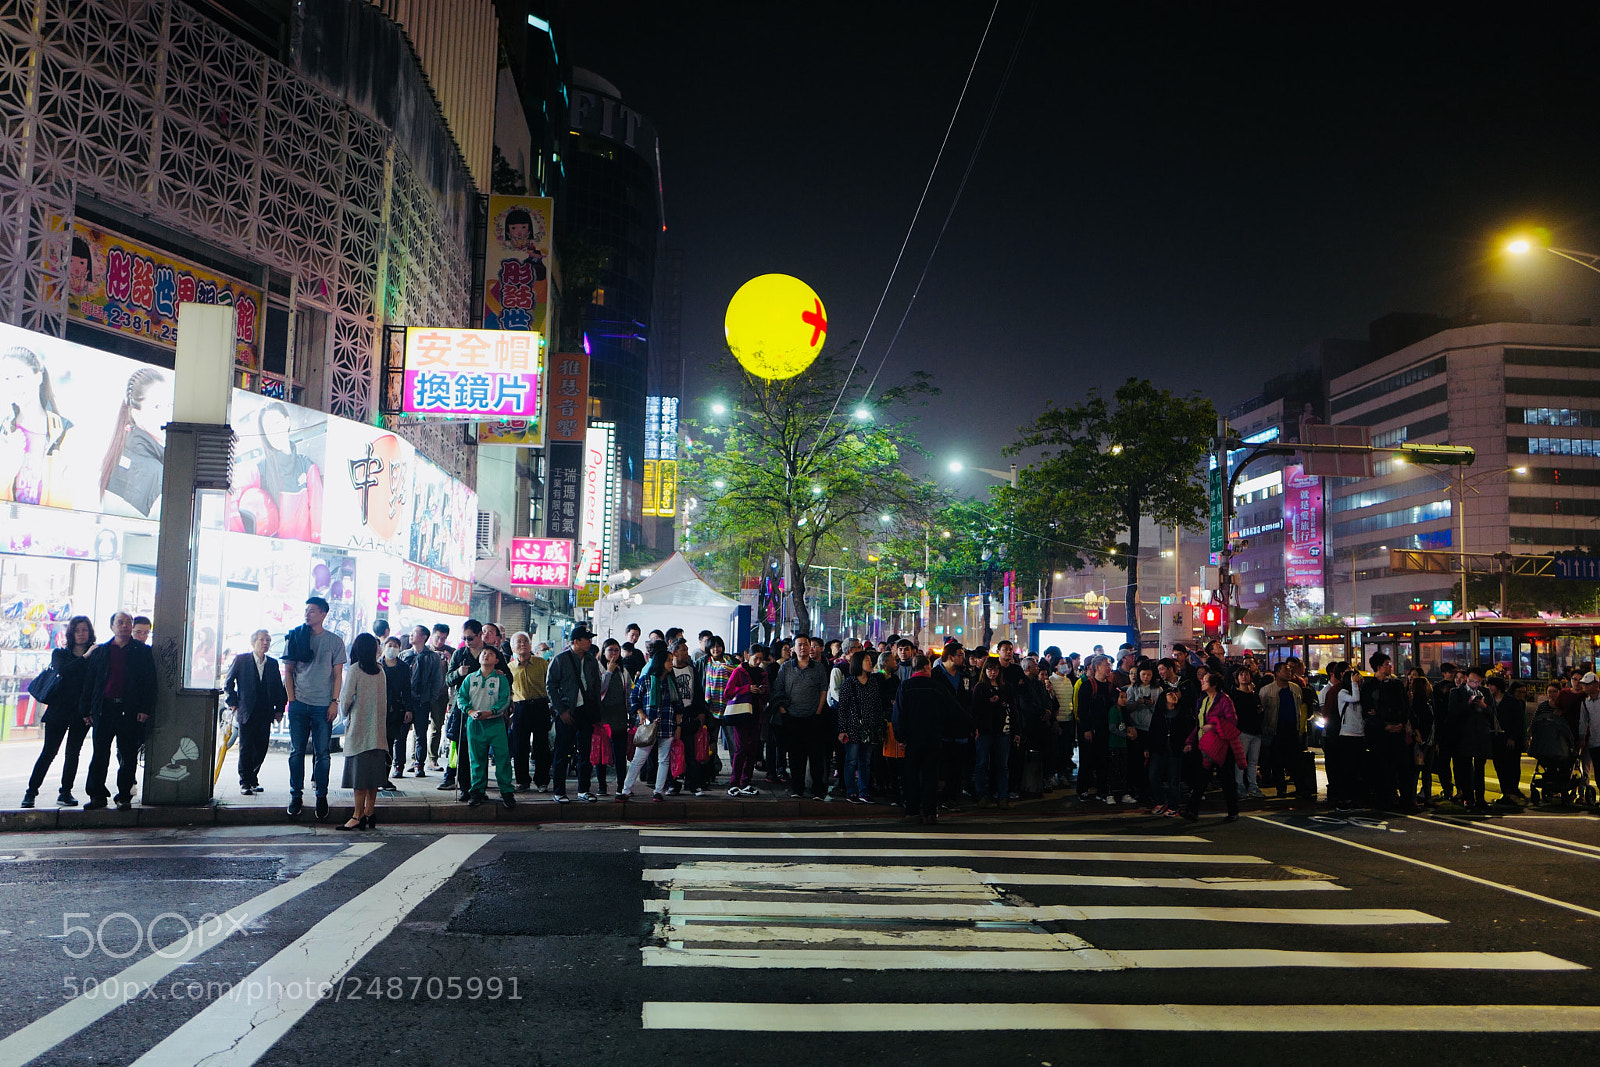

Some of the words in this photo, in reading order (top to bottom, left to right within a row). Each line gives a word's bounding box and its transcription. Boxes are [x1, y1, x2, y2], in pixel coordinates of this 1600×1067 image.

[416, 332, 531, 370] 安全帽
[415, 372, 530, 411] 換鏡片
[555, 359, 582, 438] 雅瑟音響
[552, 468, 562, 532] 工業有限公司
[562, 467, 577, 534] 瑞瑪電氣
[586, 448, 603, 530] Pioneer
[661, 482, 673, 508] Sleep
[513, 564, 567, 582] 頭部按摩
